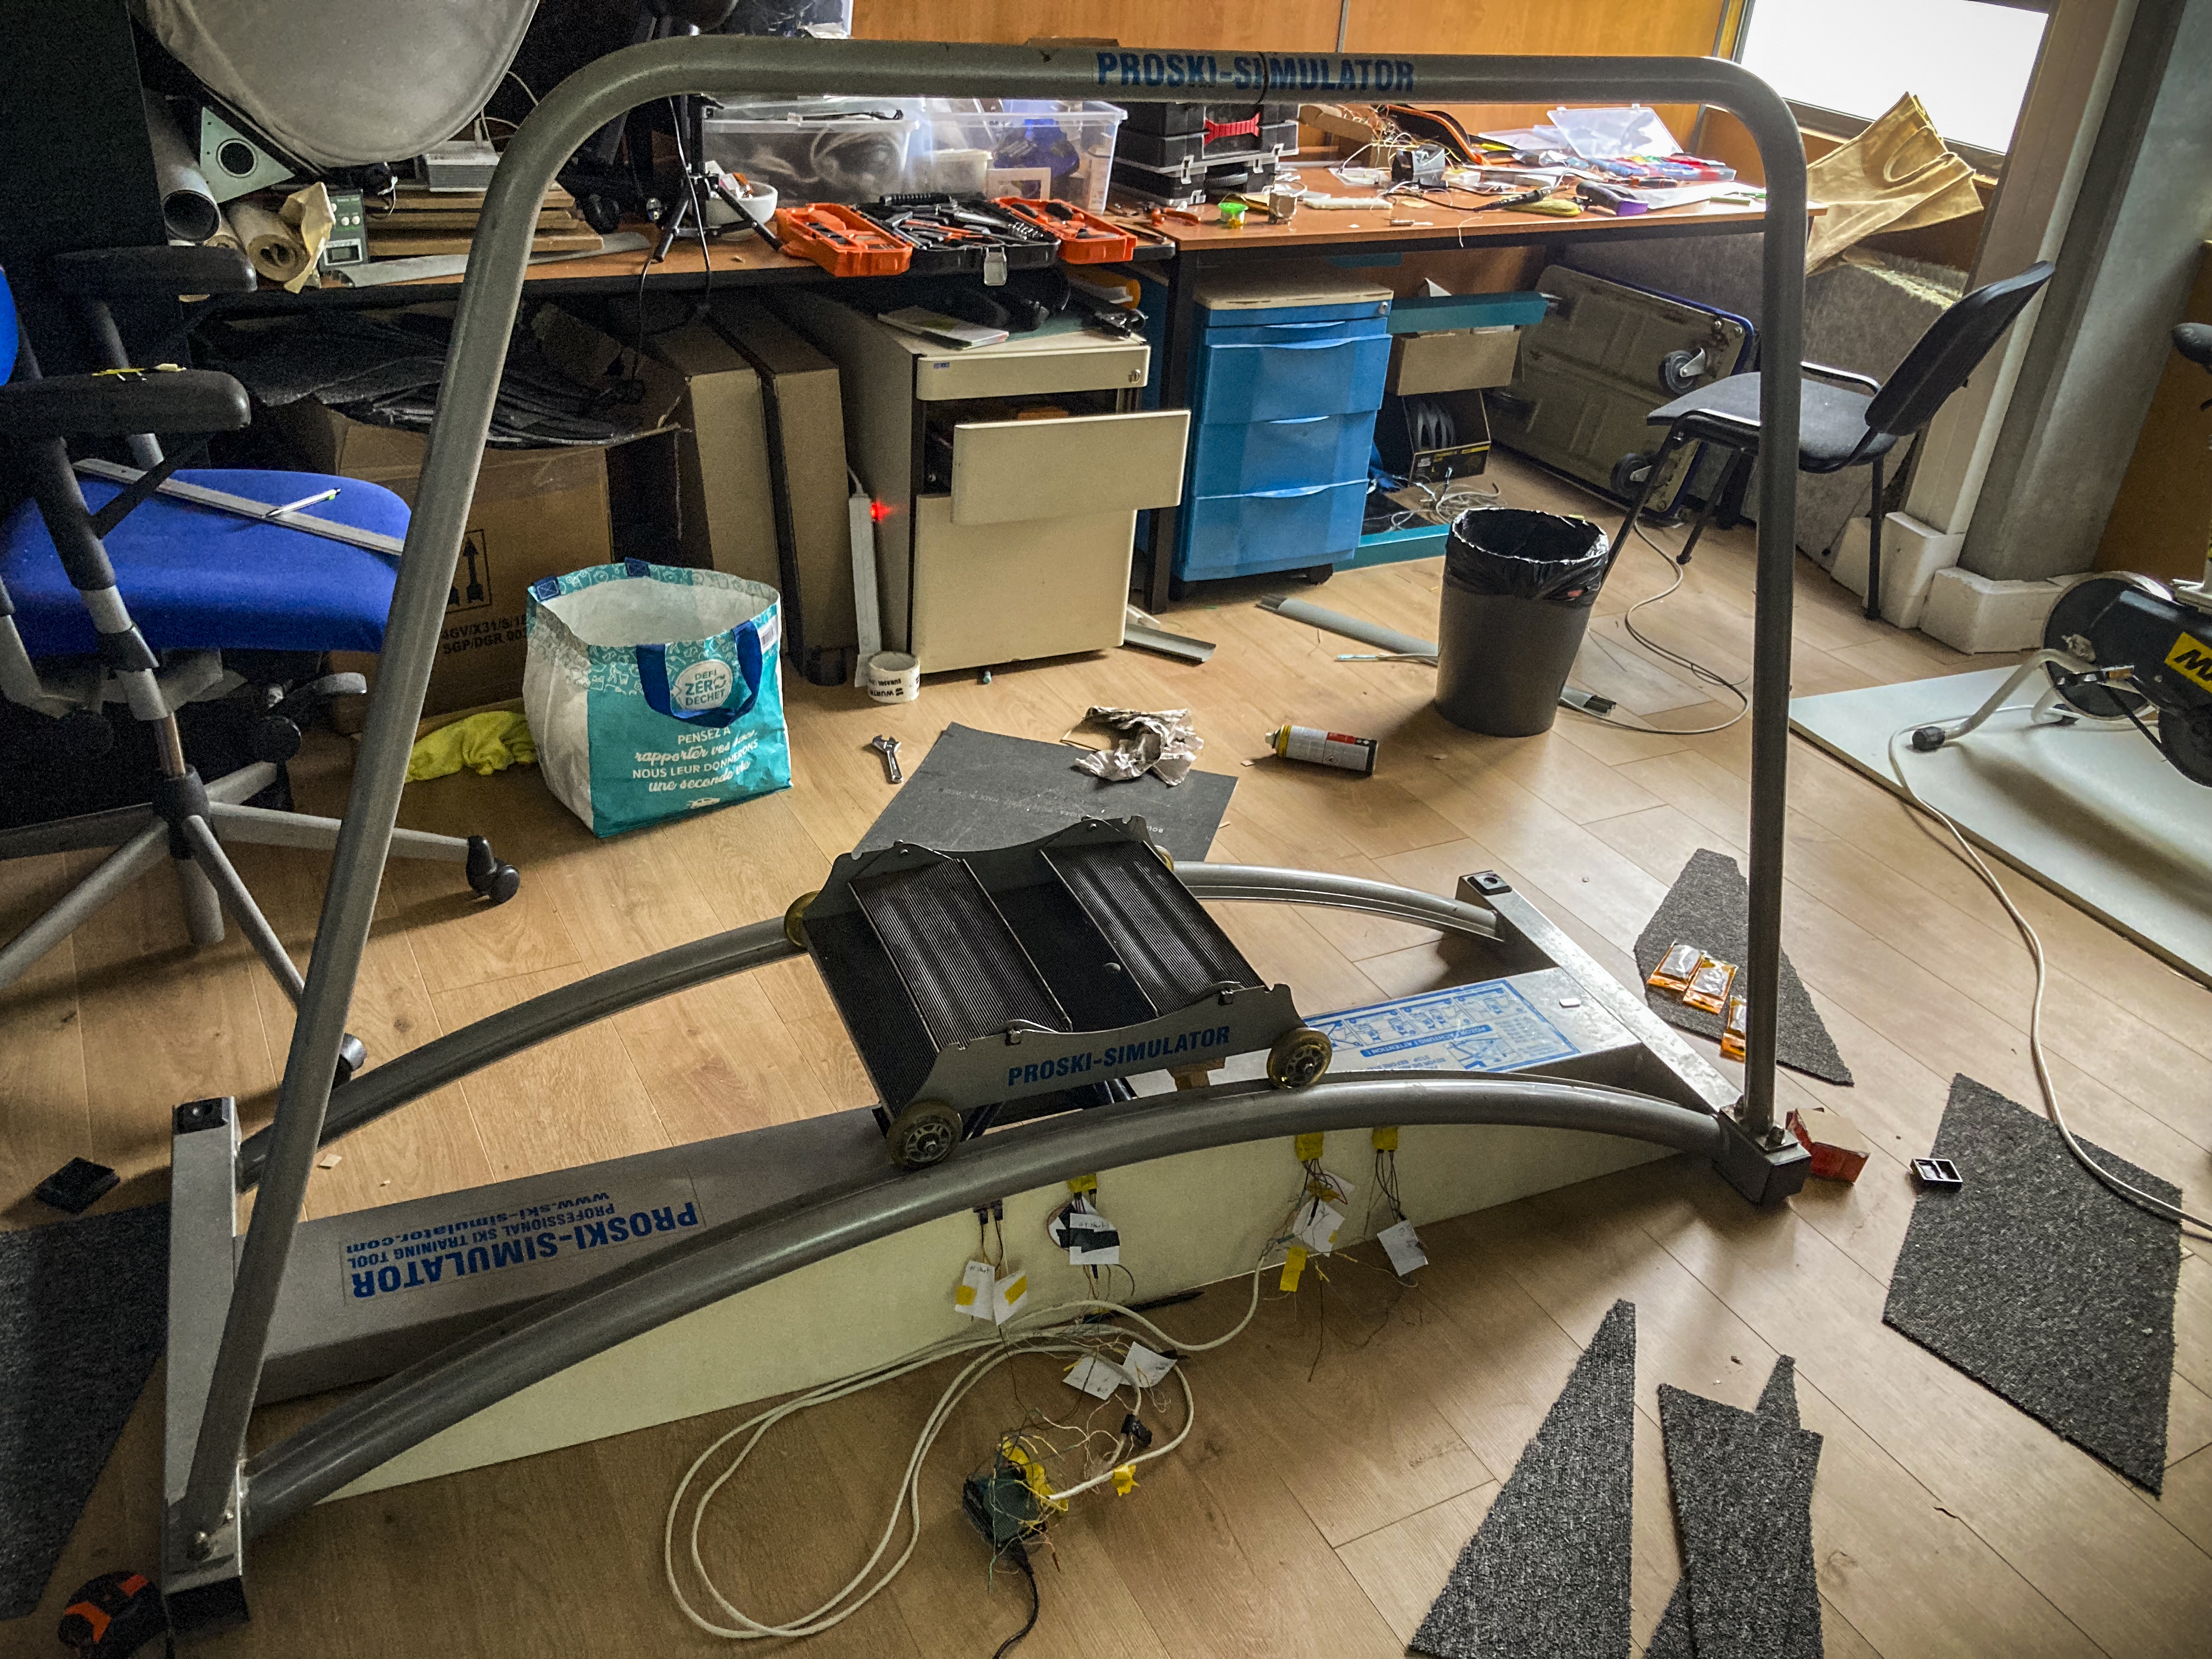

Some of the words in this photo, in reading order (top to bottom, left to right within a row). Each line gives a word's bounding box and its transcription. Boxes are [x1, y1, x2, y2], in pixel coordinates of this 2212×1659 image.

[1097, 52, 1414, 93] PROSKI-SIMULATOR
[678, 727, 721, 745] PENSEZ
[632, 768, 667, 779] NOUS
[670, 764, 701, 776] LEUR
[704, 738, 759, 772] DONNERONS
[635, 745, 709, 766] rapporter
[711, 742, 731, 756] vos
[648, 780, 678, 793] une
[679, 767, 734, 790] seconde
[736, 759, 751, 776] vie
[1008, 1025, 1231, 1086] PROSKI-SIMULATOR
[1372, 1042, 1412, 1054] ATTENTION
[346, 1192, 610, 1254] www.ski-simulator.com
[472, 1228, 498, 1244] SKI
[502, 1203, 615, 1236] PROFESSIONAL
[347, 1251, 389, 1269] TOOL
[352, 1201, 698, 1298] PROSKI-SIMULATOR
[393, 1234, 469, 1260] TRAINING
